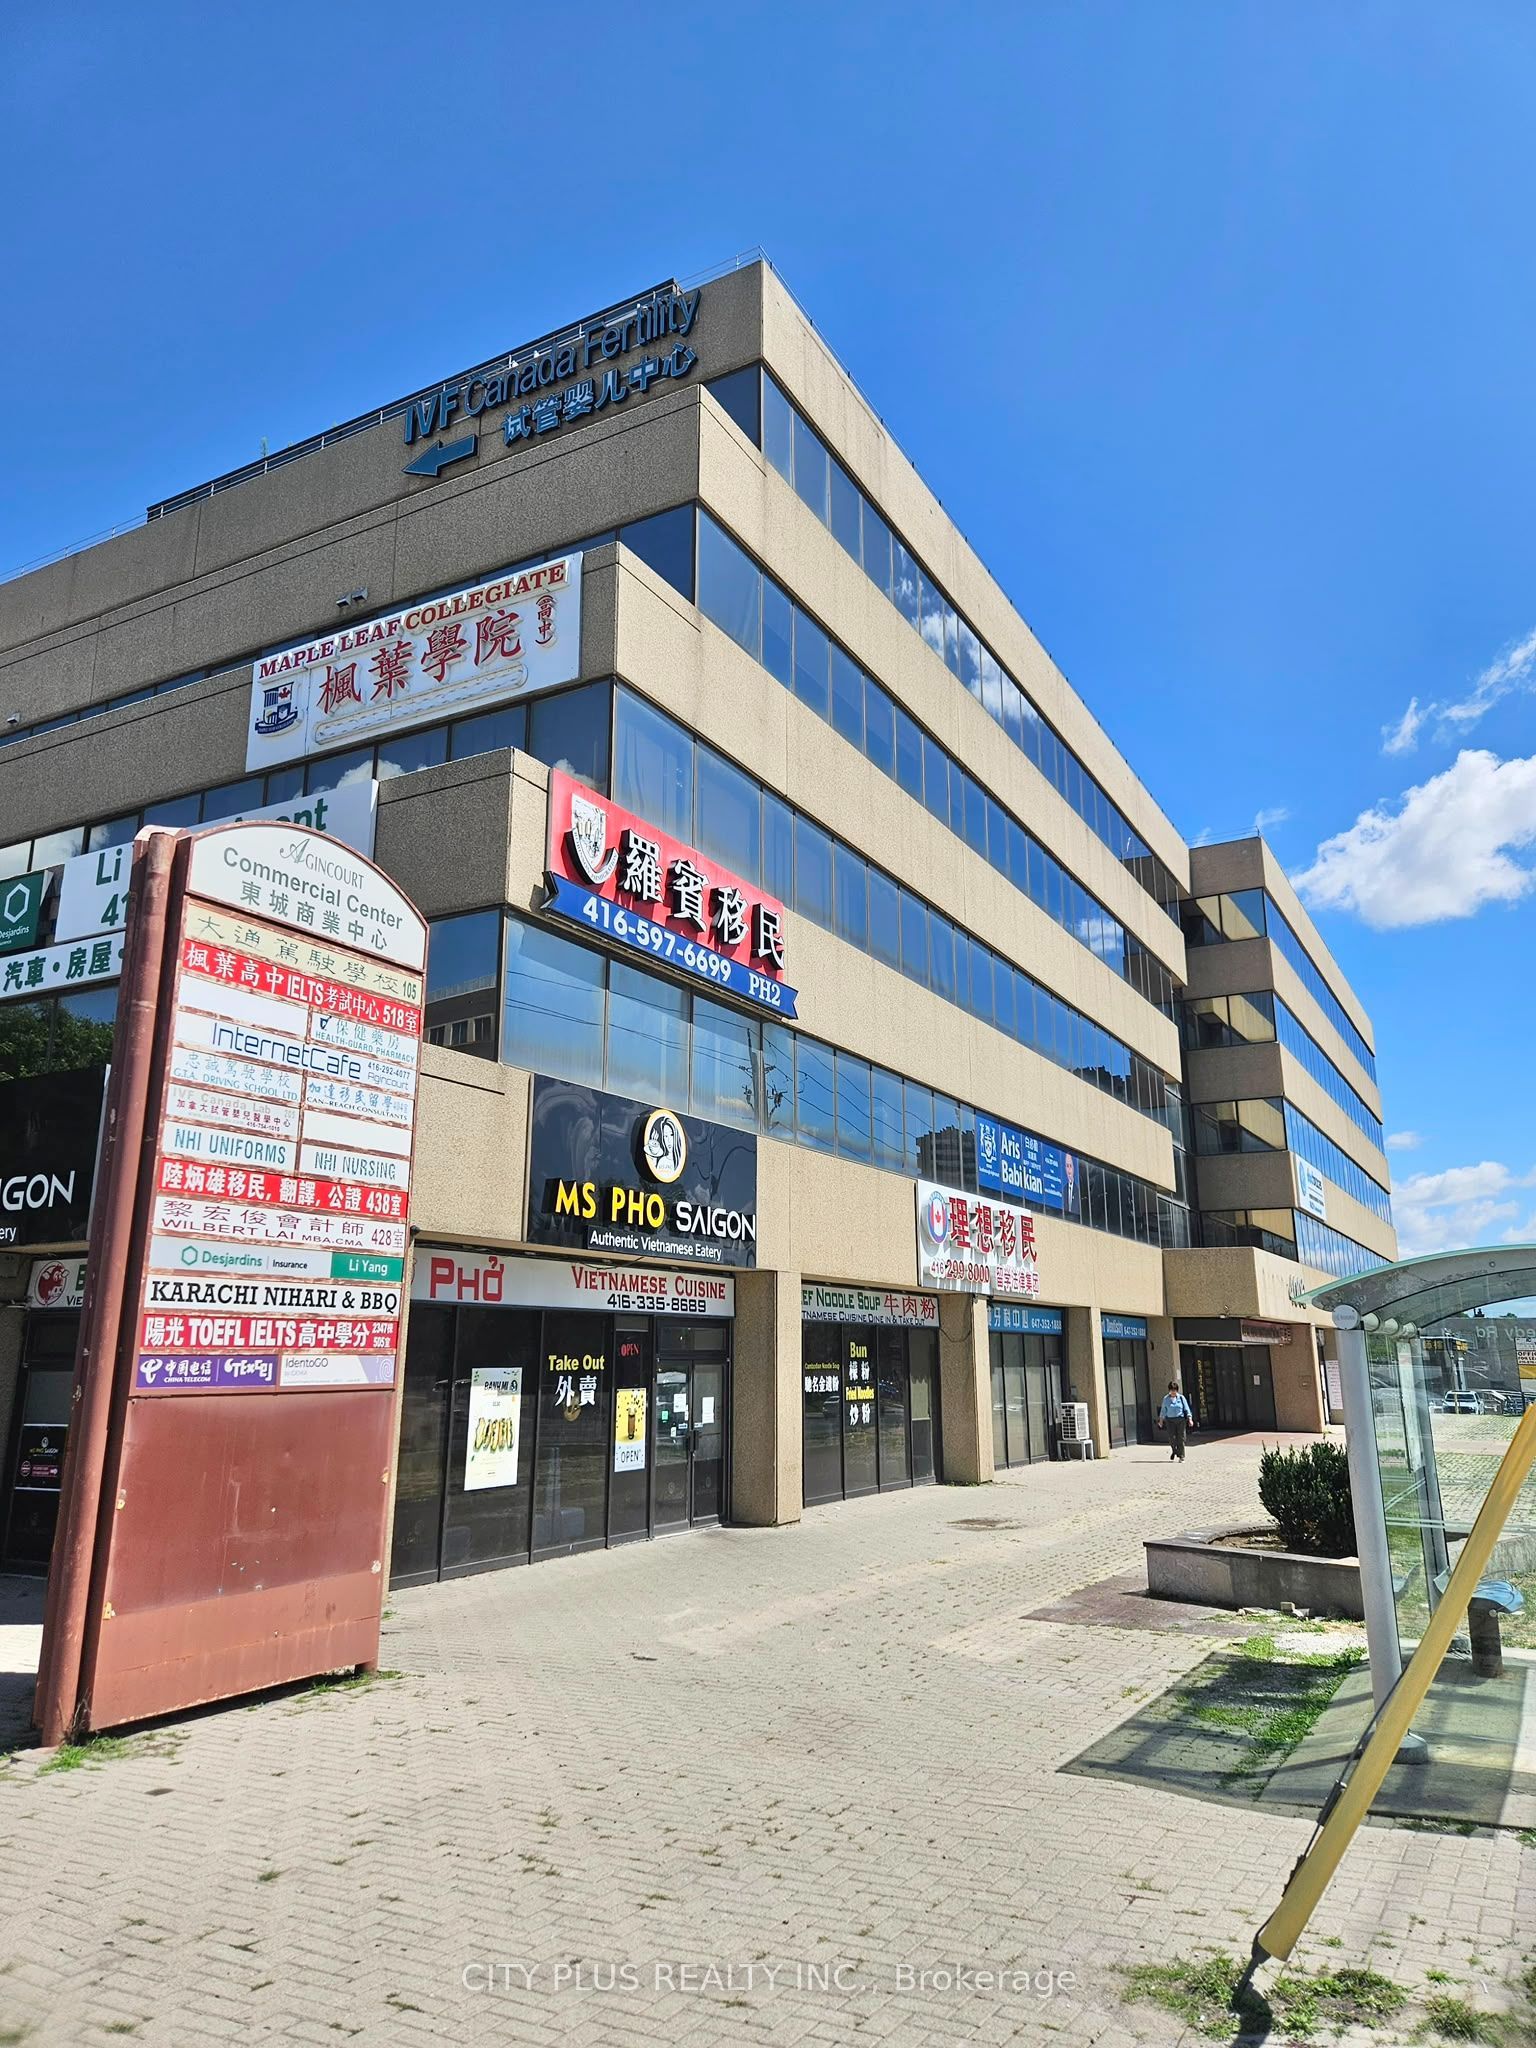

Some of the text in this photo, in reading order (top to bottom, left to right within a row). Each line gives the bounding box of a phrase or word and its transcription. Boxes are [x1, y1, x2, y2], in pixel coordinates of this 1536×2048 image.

[404, 289, 701, 444] IVF Canada Fertility
[503, 343, 698, 447] 试管婴儿中心
[259, 563, 567, 679] MAPLE LEAF COLLEGIATE
[317, 609, 521, 714] 楓葉學院
[96, 849, 122, 885] Li
[223, 847, 403, 930] Commercial Center
[623, 829, 784, 970] 羅賓移民
[240, 880, 388, 950] 東城商業中心
[582, 896, 732, 982] 416-597-6699
[197, 916, 417, 1000] 大通駕駛學校 105
[748, 972, 781, 1007] PH2
[315, 1031, 415, 1063] HEALTH-GUARD PHARMACY
[203, 1073, 240, 1089] DRIVING
[243, 1082, 278, 1097] SCHOOL
[368, 1061, 411, 1080] 416-292-4077
[173, 1087, 195, 1100] IVF
[201, 1093, 247, 1110] Canada
[252, 1102, 271, 1114] Lab
[356, 1105, 408, 1121] CONSULTANTS
[174, 1129, 286, 1165] NHI UNIFORMS
[1001, 1131, 1020, 1160] Aris
[314, 1151, 397, 1181] NHI NURSING
[1001, 1159, 1043, 1195] Babikian
[555, 1178, 756, 1241] MS PHO SAIGON
[160, 1218, 260, 1237] WILBERT
[265, 1227, 295, 1241] LAI
[948, 1196, 1037, 1263] 理想移民
[202, 1250, 308, 1270] Desjardins Insurance
[590, 1230, 722, 1262] Authentic Vietnamese Eatery
[349, 1258, 389, 1276] Li Yang
[571, 1265, 726, 1300] VIETNAMESE CUISINE
[150, 1281, 397, 1314] KARACHI NIHARI & BBQ
[606, 1293, 707, 1313] 416-335-8689
[816, 1288, 855, 1310] NOODLE
[857, 1291, 881, 1311] SOUP
[884, 1294, 936, 1320] 牛肉粉
[145, 1317, 184, 1347] 陽光
[188, 1319, 245, 1347] TOEFL
[248, 1320, 296, 1347] IELTS
[839, 1311, 867, 1322] CUISINE
[868, 1313, 884, 1324] DINE
[898, 1315, 913, 1326] TAKE
[548, 1354, 605, 1372] Take Out
[620, 1342, 639, 1356] OPEN
[850, 1342, 867, 1358] Bun
[165, 1359, 212, 1377] 中国电信
[554, 1374, 598, 1408] 外賣
[845, 1386, 875, 1401] Fried Noodles
[620, 1450, 639, 1464] OPEN
